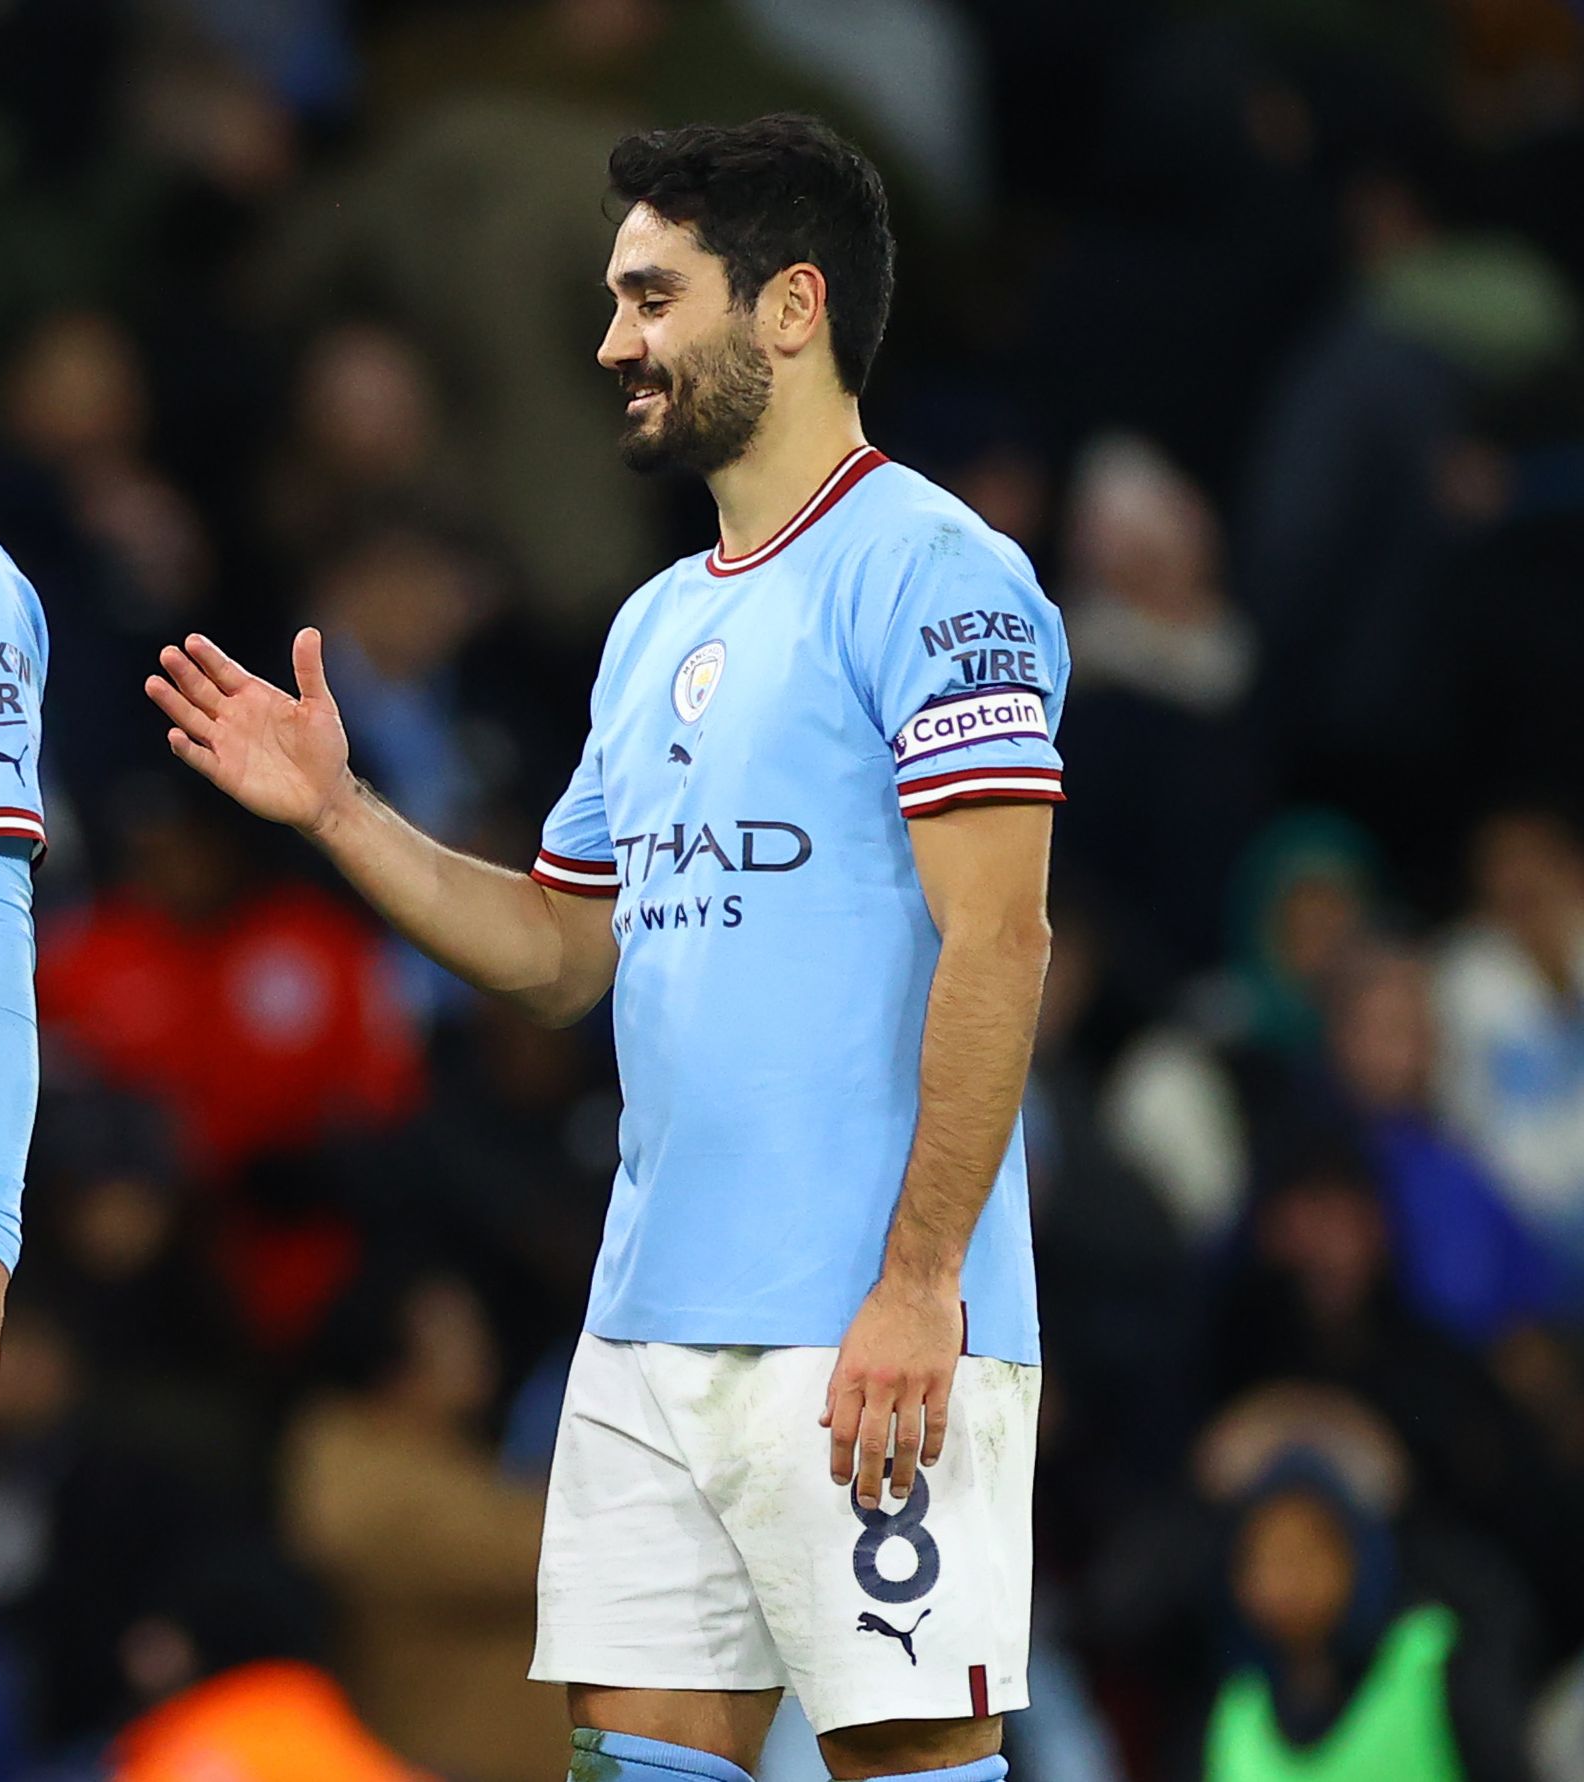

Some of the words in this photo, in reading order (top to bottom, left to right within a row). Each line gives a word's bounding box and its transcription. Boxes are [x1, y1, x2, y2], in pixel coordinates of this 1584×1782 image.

[920, 610, 1036, 657] NEXEN
[951, 649, 1038, 684] TIRE
[913, 698, 1038, 743] Captain
[850, 1457, 940, 1604] 8
